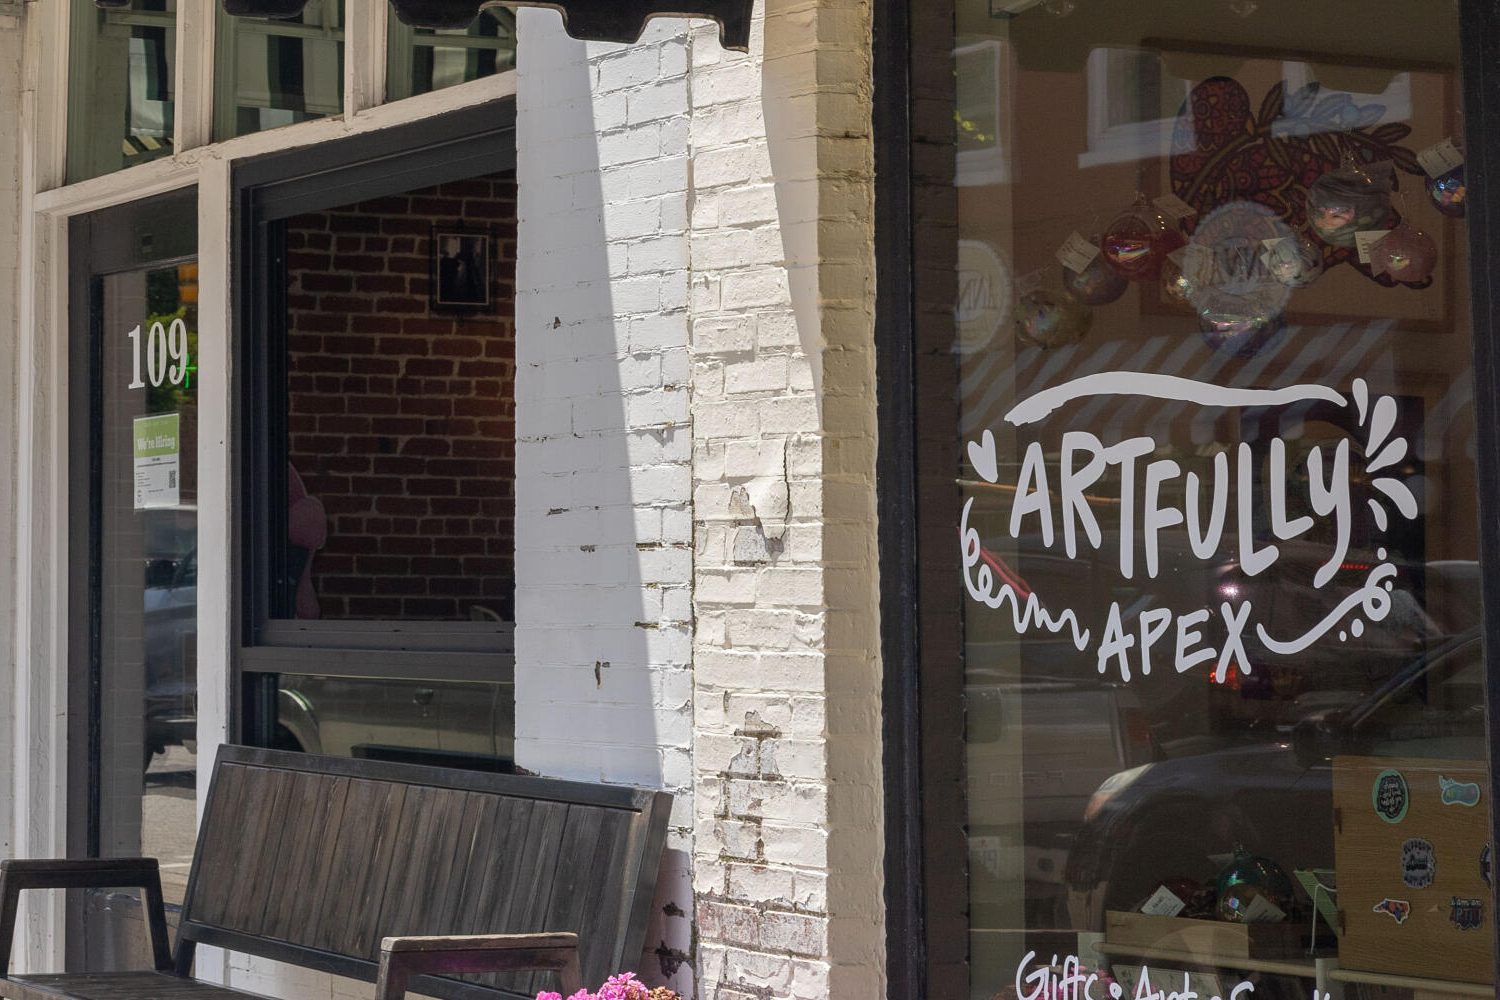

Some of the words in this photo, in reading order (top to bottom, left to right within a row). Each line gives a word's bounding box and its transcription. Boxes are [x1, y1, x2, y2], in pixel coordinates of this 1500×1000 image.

[127, 317, 188, 390] 109
[1008, 430, 1352, 588] ARTFULLY
[1097, 600, 1252, 683] APEX
